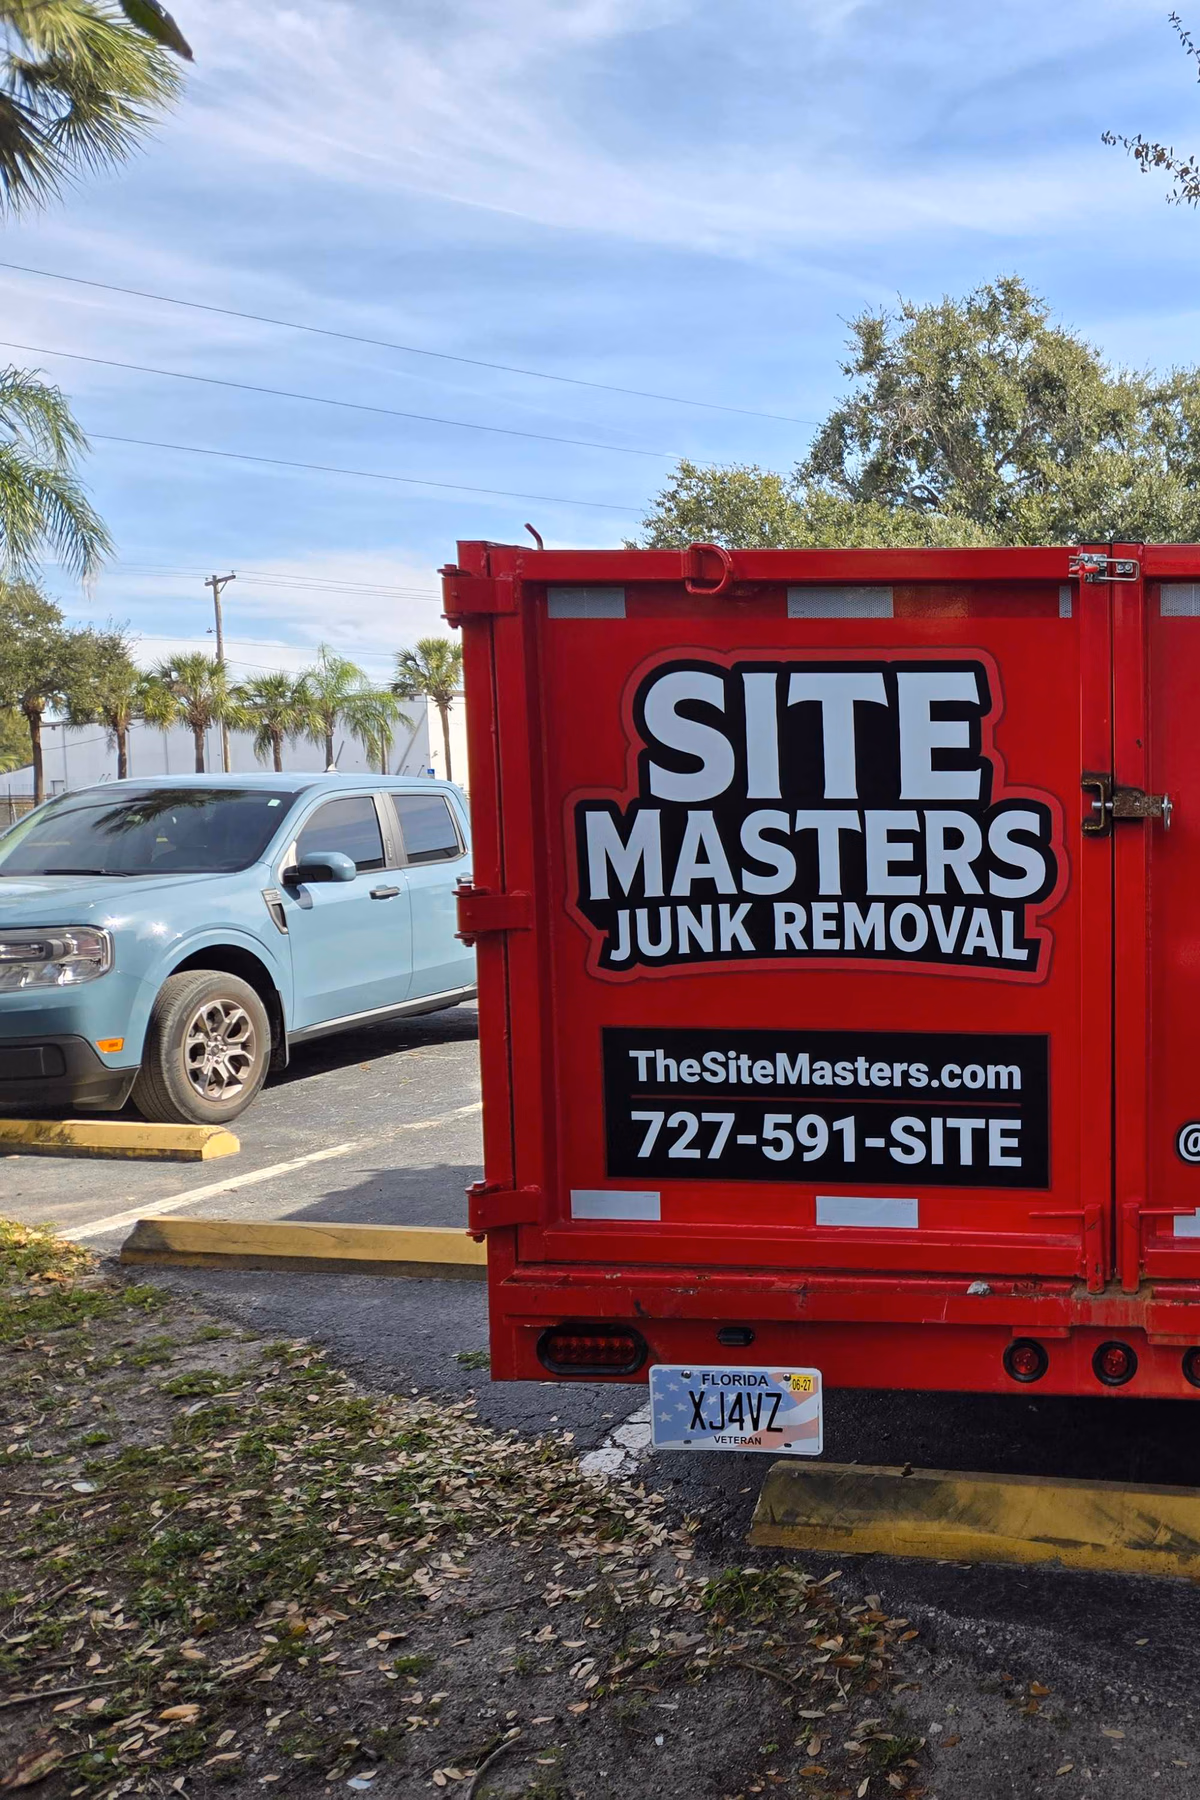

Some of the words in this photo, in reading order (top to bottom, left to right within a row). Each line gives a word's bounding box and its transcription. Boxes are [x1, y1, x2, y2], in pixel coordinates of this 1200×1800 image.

[644, 671, 981, 802] SITE
[585, 809, 1046, 900] MASTERS
[609, 903, 753, 961] JUNK
[774, 902, 1028, 961] REMOVAL
[629, 1049, 1022, 1090] TheSiteMasters.com
[631, 1111, 1022, 1167] 727-591-SITE
[702, 1373, 769, 1387] FLORIDA
[792, 1379, 811, 1391] 06-27
[688, 1390, 783, 1432] XJ4VZ
[714, 1435, 762, 1445] VETERAN
